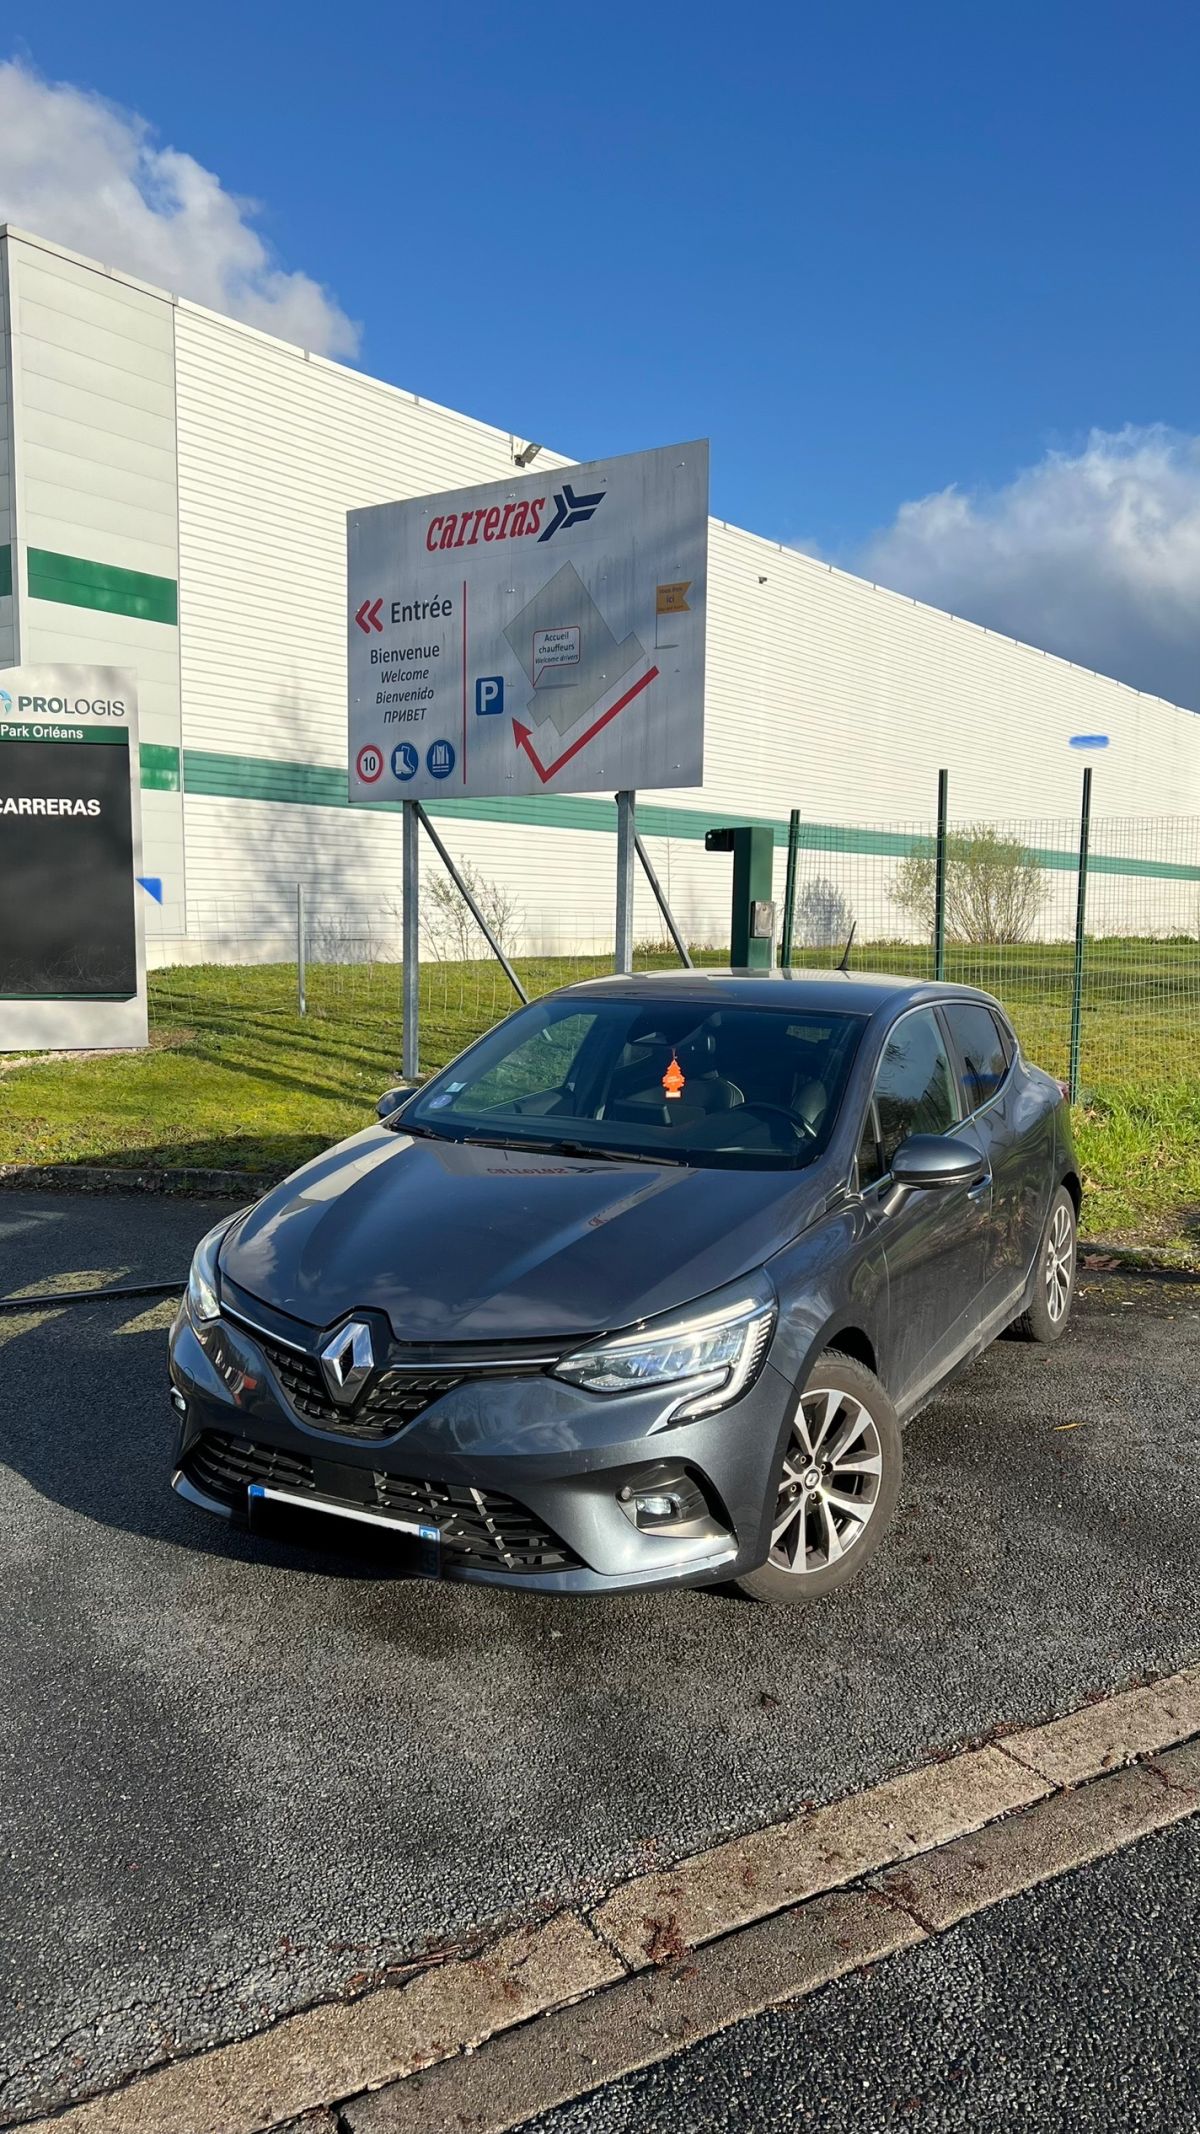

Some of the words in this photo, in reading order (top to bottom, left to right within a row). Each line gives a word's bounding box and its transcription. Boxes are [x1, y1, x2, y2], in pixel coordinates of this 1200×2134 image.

[426, 497, 546, 551] carreras
[391, 594, 452, 623] Entrée
[544, 631, 569, 642] Accueil
[370, 645, 440, 665] Bienvenue
[538, 643, 575, 654] chauffeurs
[381, 668, 429, 683] Welcome
[376, 687, 434, 704] Bienvenido
[481, 680, 499, 712] P
[18, 695, 126, 717] PROLOGIS
[383, 708, 427, 724] ПРИВЕТ
[0, 724, 30, 738] Park
[32, 725, 84, 740] Orléans
[363, 757, 376, 771] 10
[0, 797, 101, 816] ARRERAS
